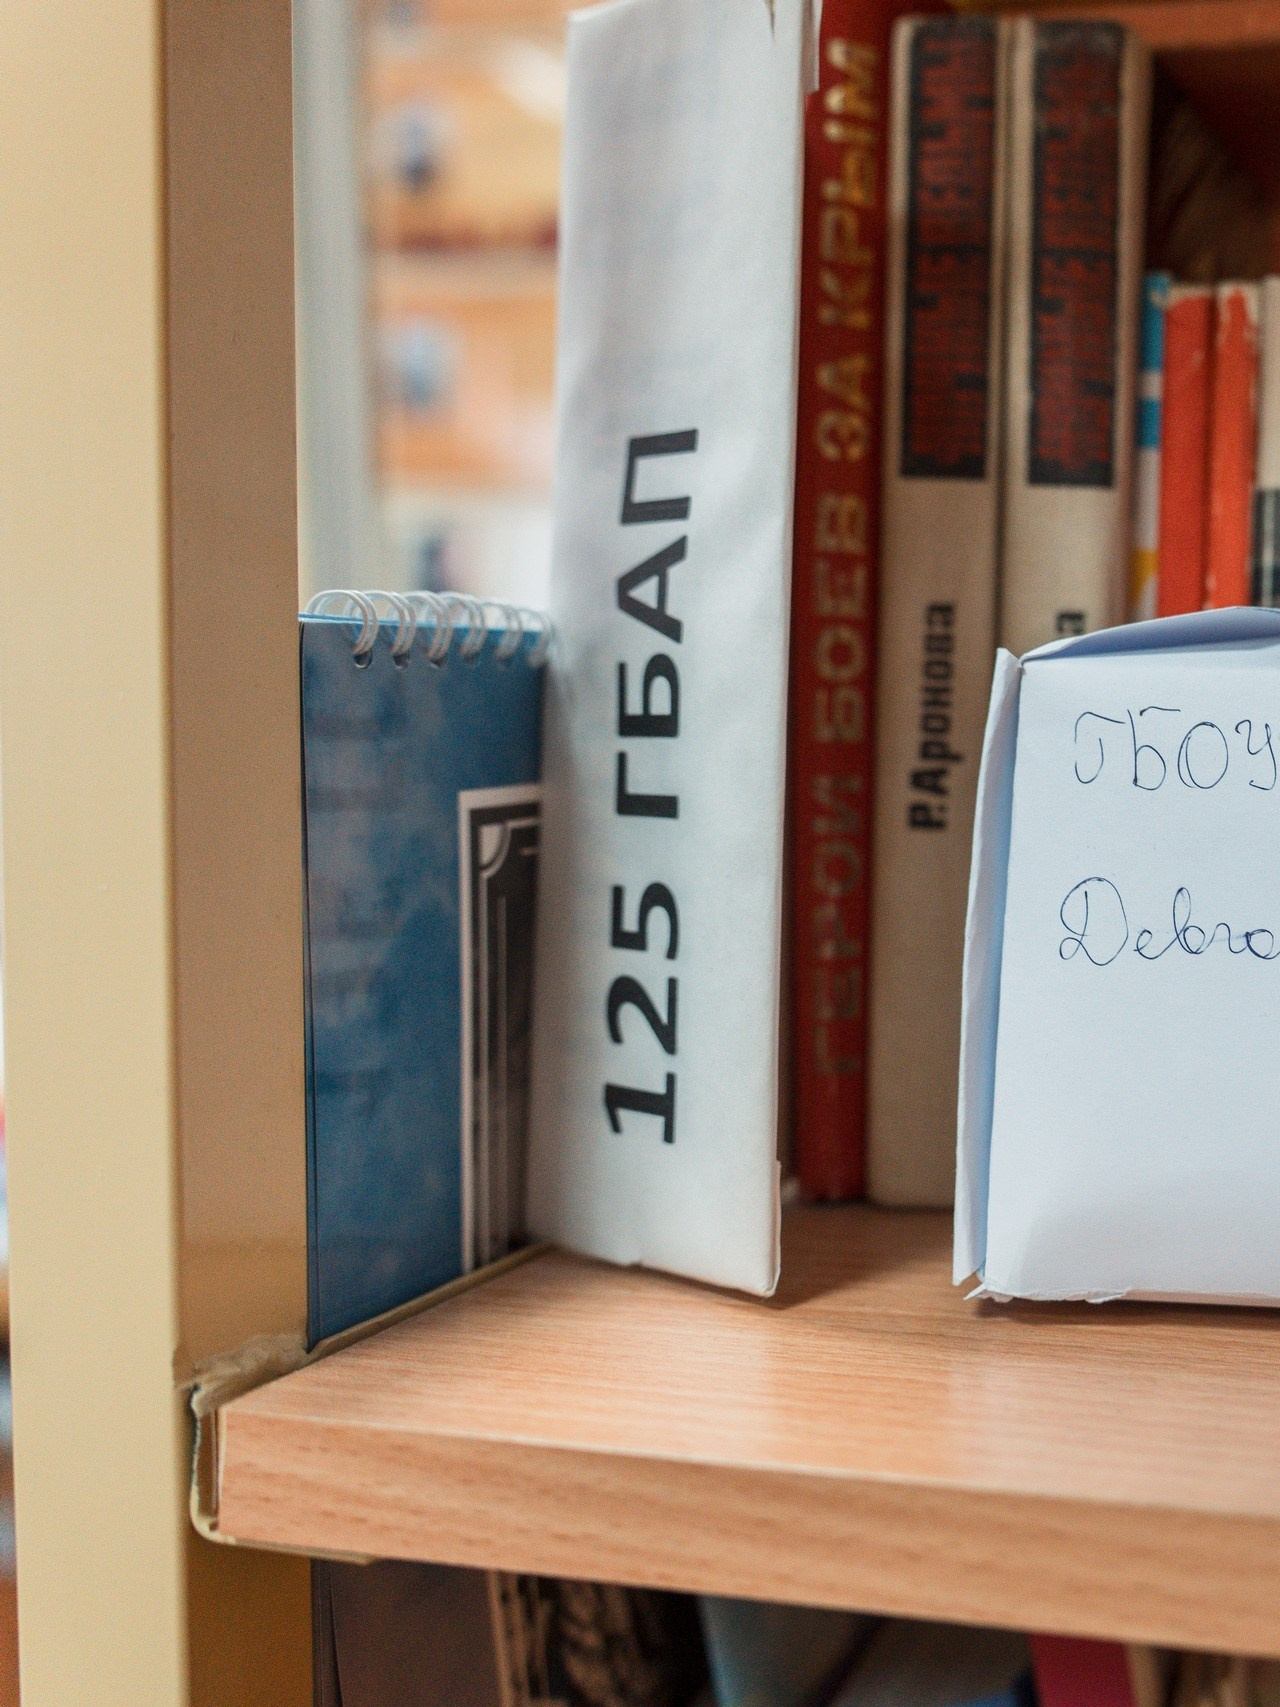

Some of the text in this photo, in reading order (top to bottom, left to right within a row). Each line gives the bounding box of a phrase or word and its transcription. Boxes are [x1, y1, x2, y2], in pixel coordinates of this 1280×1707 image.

[604, 428, 698, 1144] 125 ГБАП
[811, 36, 878, 1077] ГЕРОИ БОЕВ ЗА КРЫМ
[1074, 705, 1279, 792] ГБОУ
